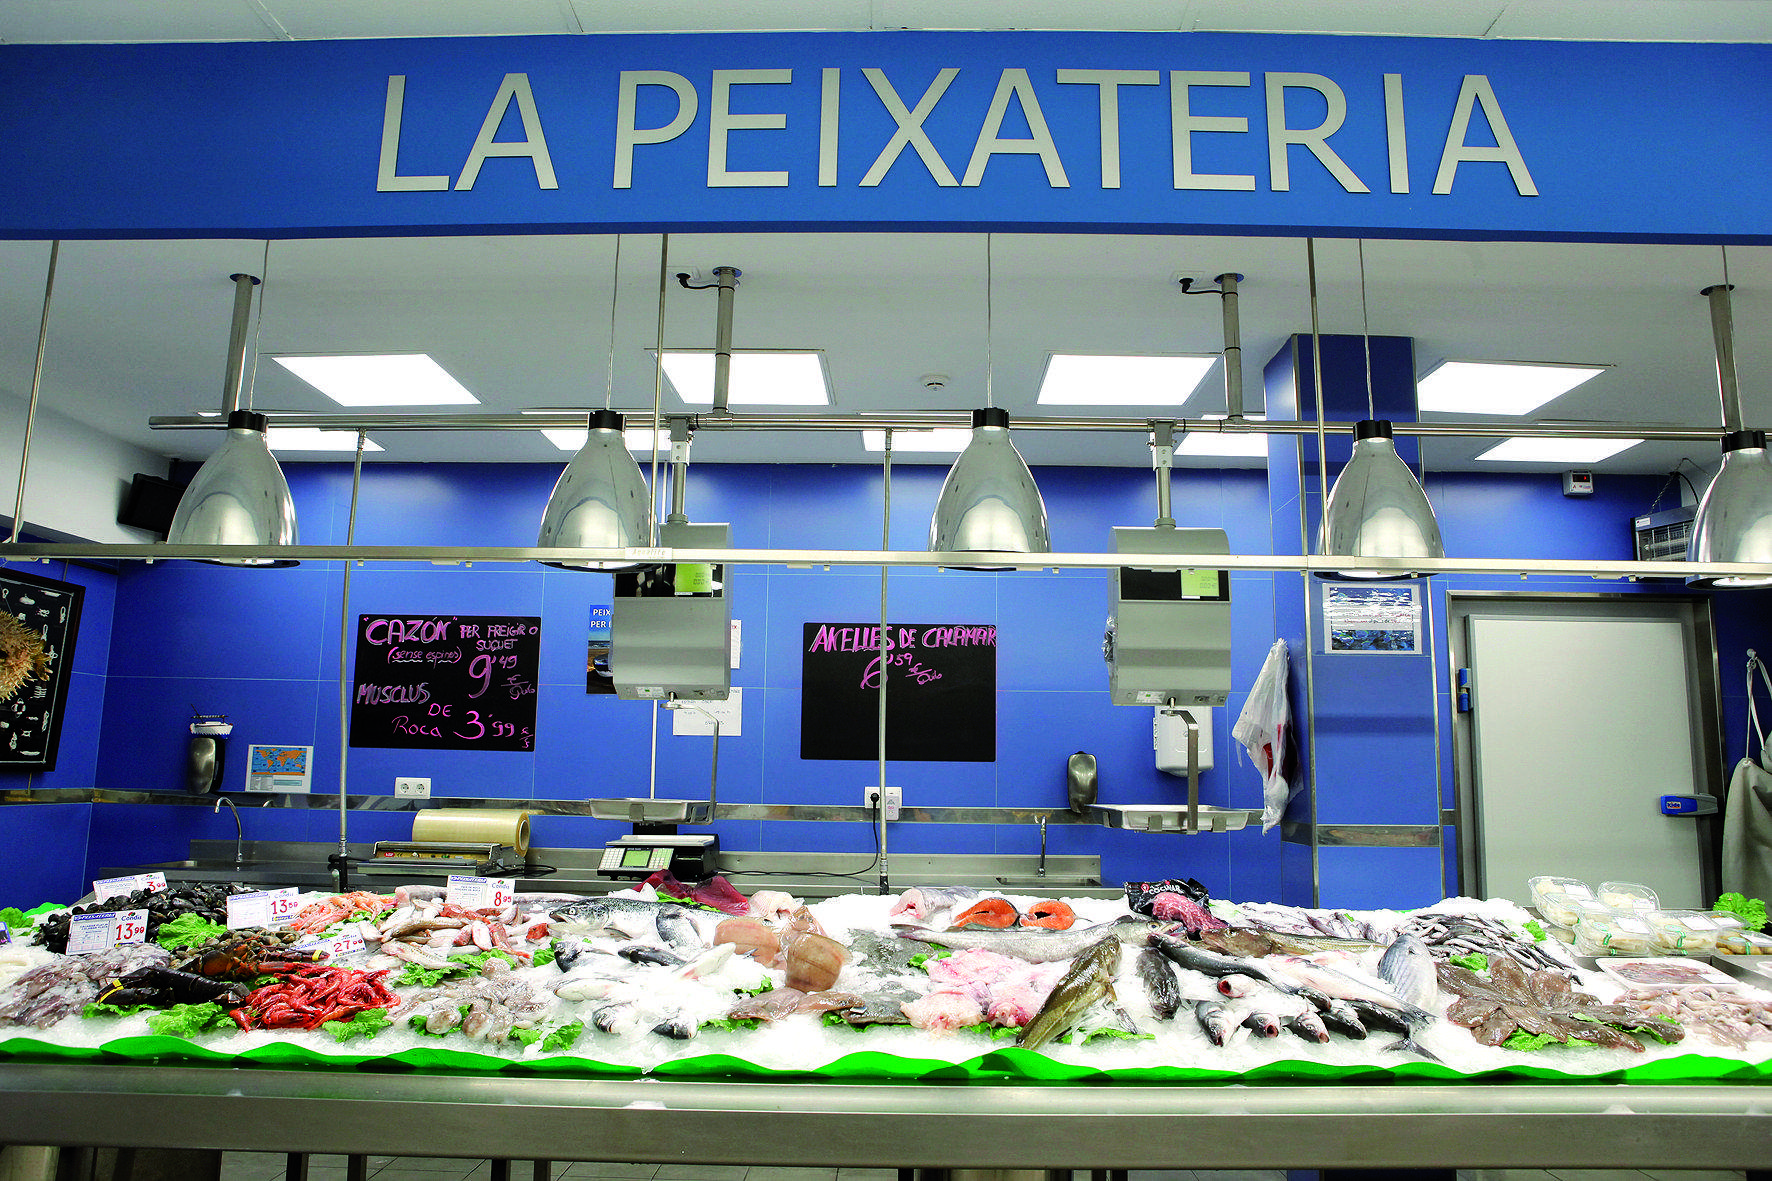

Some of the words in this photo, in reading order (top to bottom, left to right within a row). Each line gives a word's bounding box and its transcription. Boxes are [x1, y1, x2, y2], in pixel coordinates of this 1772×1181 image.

[376, 73, 559, 192] LA
[612, 66, 1541, 198] PEIXATERIA
[459, 624, 481, 639] PER
[590, 620, 606, 628] PER
[475, 638, 519, 652] SUQUET
[899, 627, 918, 649] DE
[356, 681, 431, 705] MUSCLUS
[427, 703, 453, 718] DE
